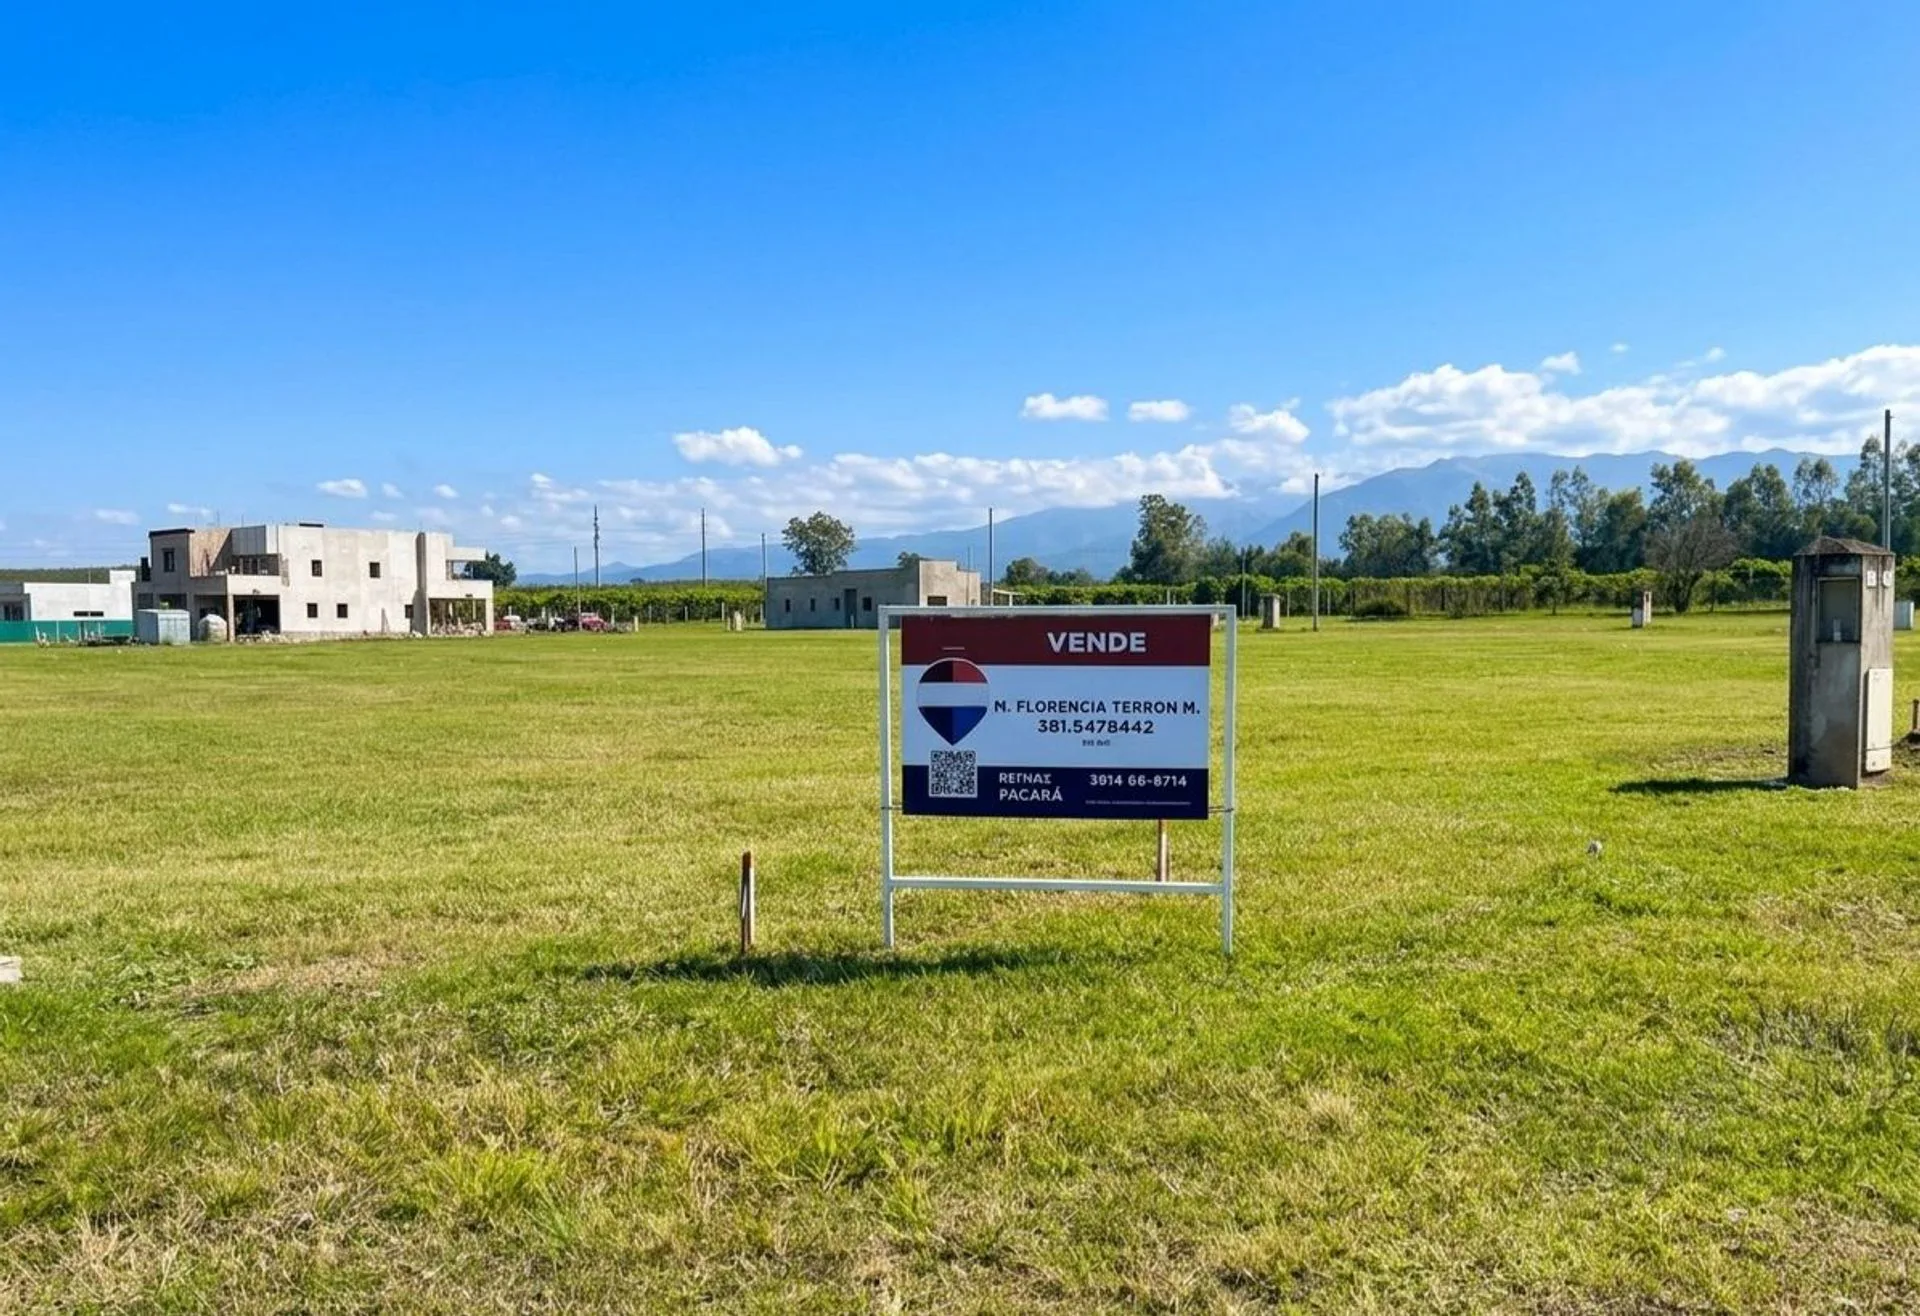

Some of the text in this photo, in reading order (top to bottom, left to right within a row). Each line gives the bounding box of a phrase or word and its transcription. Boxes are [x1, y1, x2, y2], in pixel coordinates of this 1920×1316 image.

[1047, 631, 1147, 653] VENDE
[1017, 700, 1107, 714] FLORENCIA
[1112, 701, 1178, 715] TERRON
[1182, 702, 1201, 715] M.
[1037, 719, 1154, 735] 381.5478442
[999, 786, 1063, 801] PACARÁ
